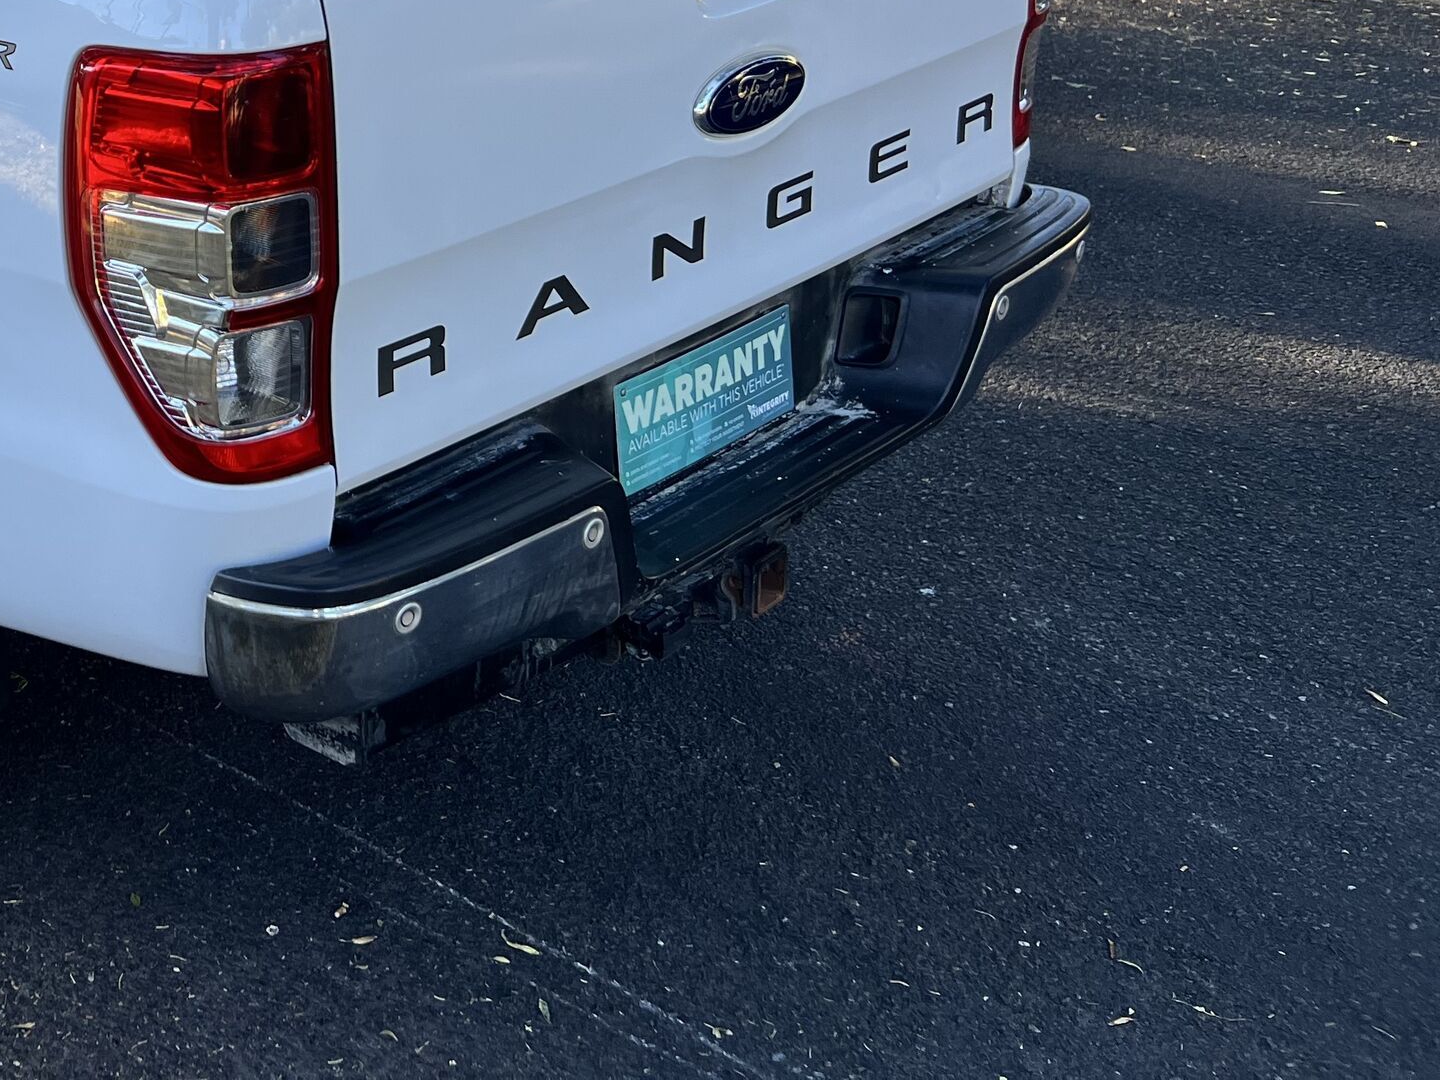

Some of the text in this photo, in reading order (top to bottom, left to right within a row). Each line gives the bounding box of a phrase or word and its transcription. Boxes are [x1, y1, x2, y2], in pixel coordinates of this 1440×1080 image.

[731, 68, 789, 122] Ford
[377, 92, 994, 398] RANGER
[621, 323, 786, 434] WARRANTY
[628, 415, 688, 455] AVAILABLE
[689, 398, 717, 422] WITH
[718, 386, 741, 410] THIS
